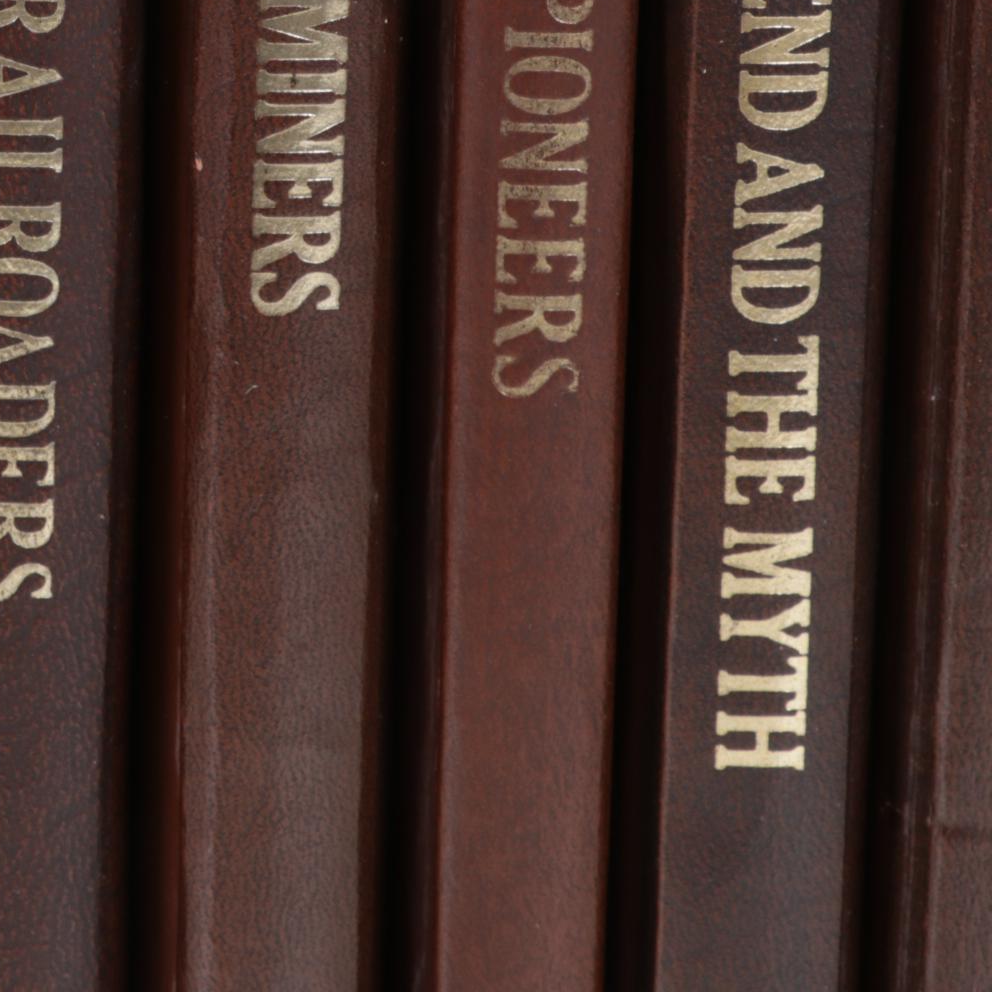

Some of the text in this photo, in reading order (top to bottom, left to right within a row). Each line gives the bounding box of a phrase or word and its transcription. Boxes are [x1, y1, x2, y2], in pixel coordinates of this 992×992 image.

[729, 141, 826, 325] AND
[723, 334, 819, 506] THE
[713, 526, 815, 774] MYTH
